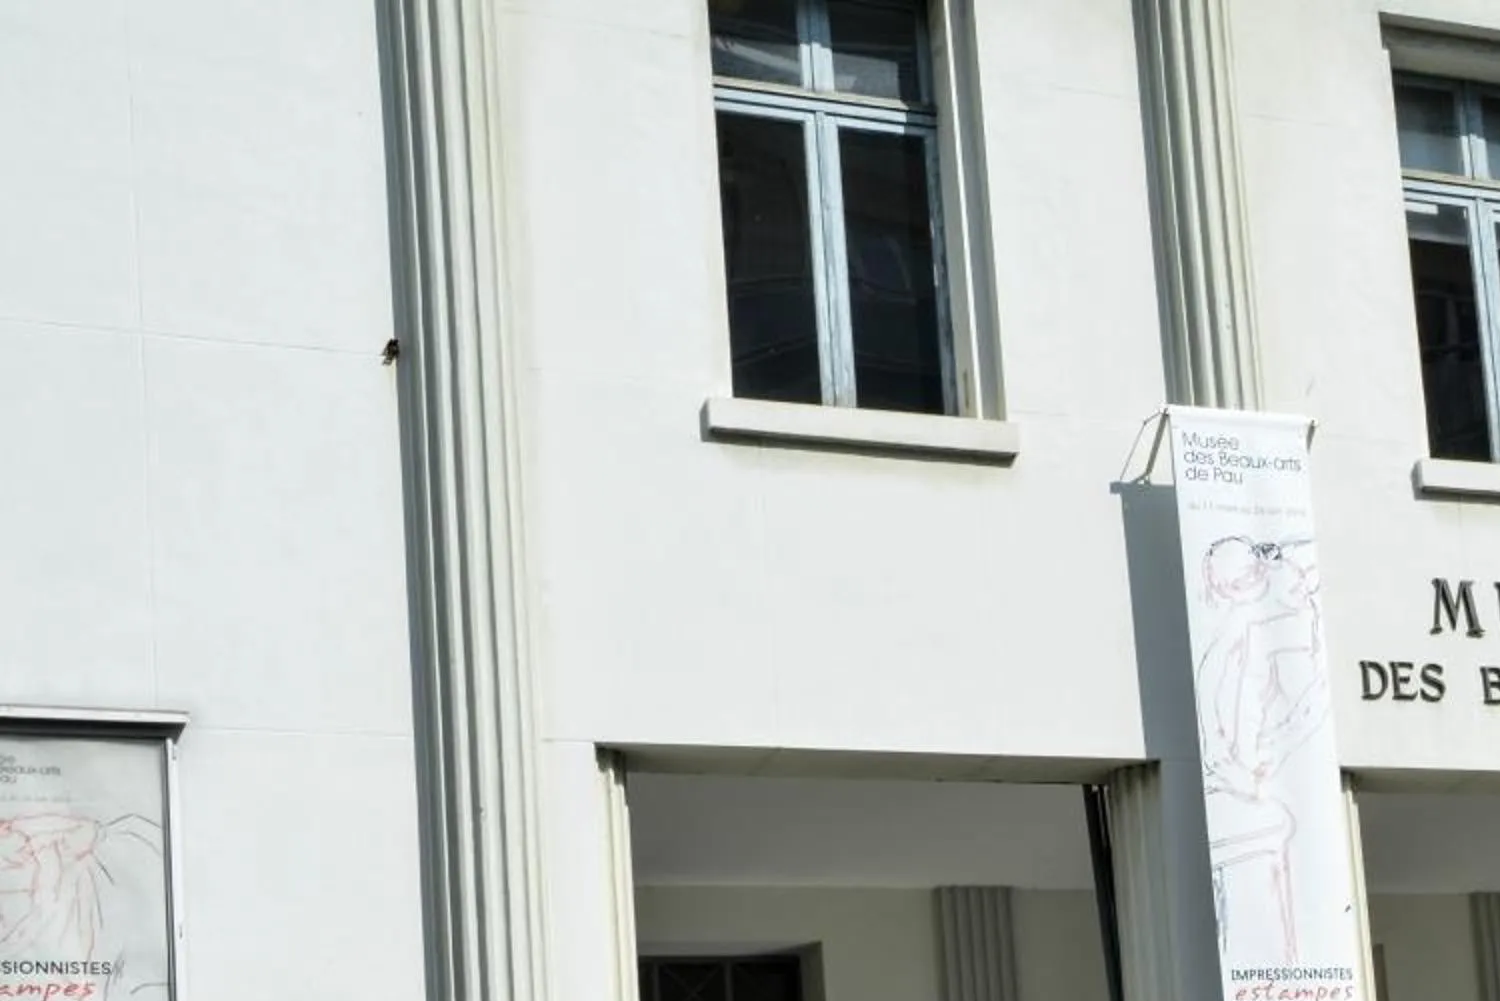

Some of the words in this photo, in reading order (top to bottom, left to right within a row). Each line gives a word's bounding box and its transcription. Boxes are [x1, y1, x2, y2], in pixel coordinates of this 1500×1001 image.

[1182, 432, 1239, 450] Musée
[1183, 449, 1214, 464] des
[1219, 451, 1302, 472] Beaux-arts
[1184, 466, 1209, 481] de
[1214, 468, 1243, 485] Pau
[1358, 660, 1446, 702] DES
[1231, 967, 1353, 981] IMPRESSIONNISTES
